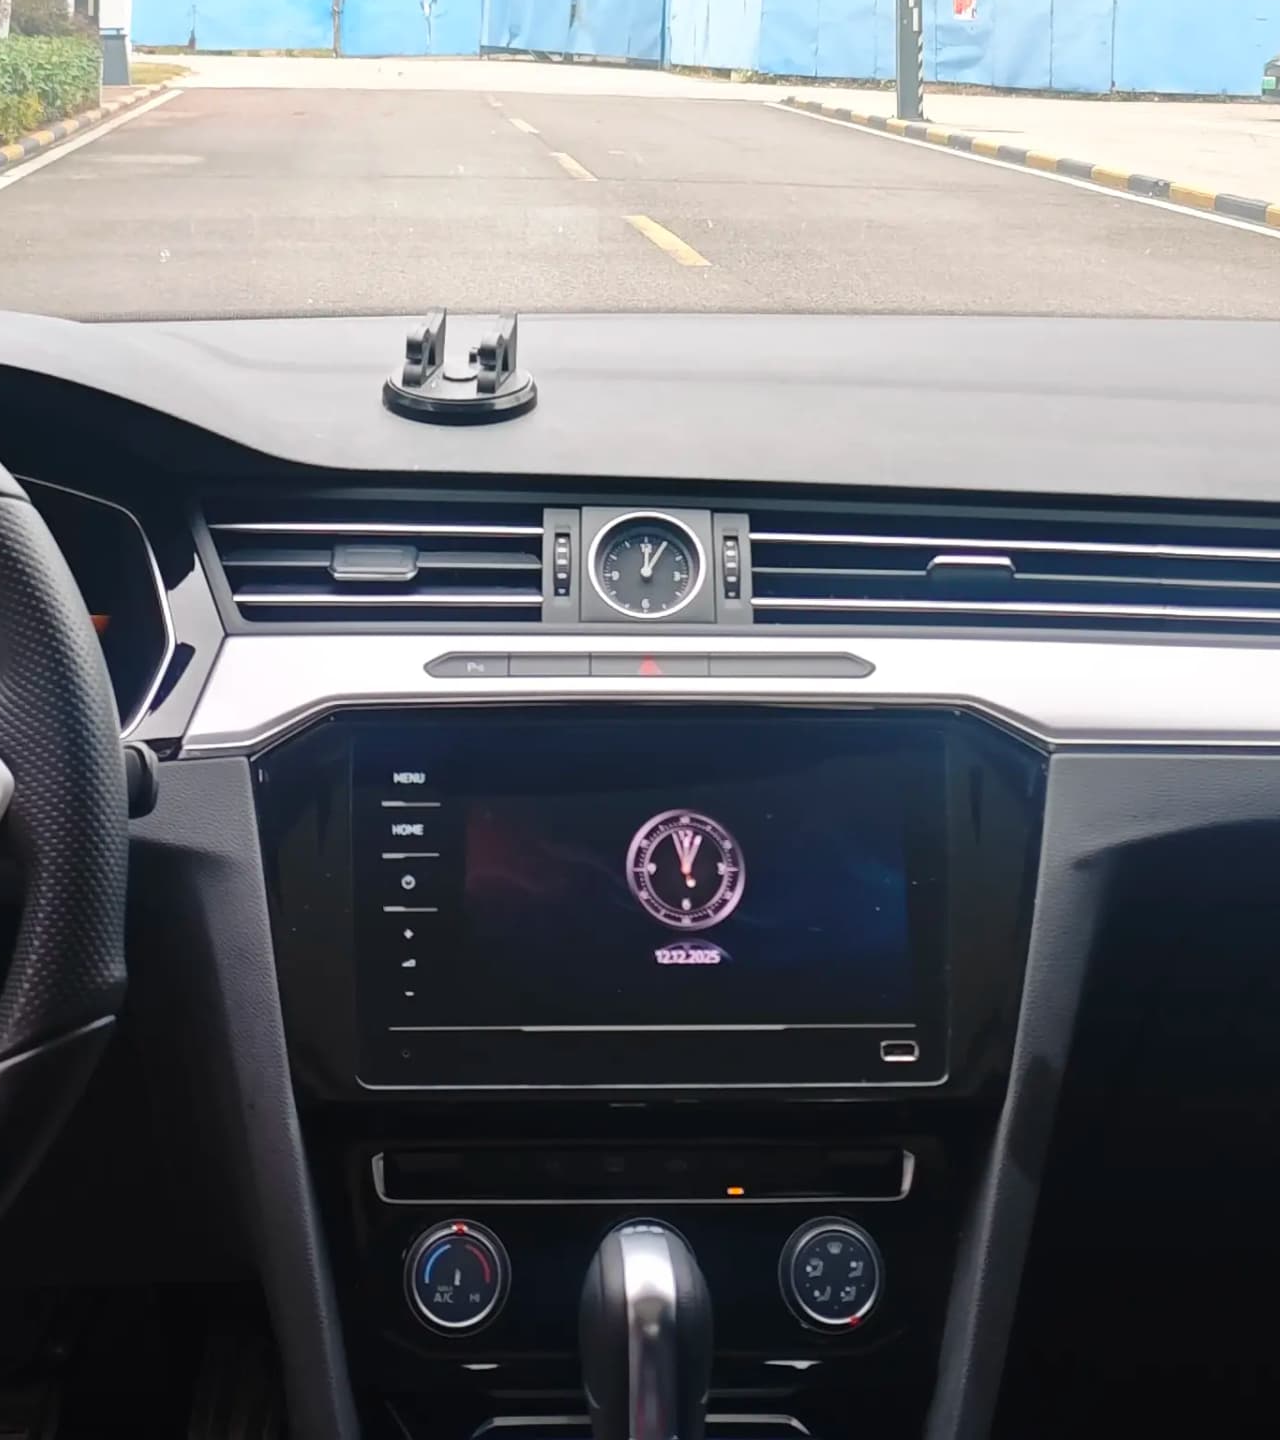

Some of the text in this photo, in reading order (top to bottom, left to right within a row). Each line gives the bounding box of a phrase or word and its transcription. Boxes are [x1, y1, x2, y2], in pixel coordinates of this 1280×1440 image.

[392, 772, 426, 784] MENU
[391, 824, 424, 836] HOME
[654, 950, 721, 964] 12.12.2025
